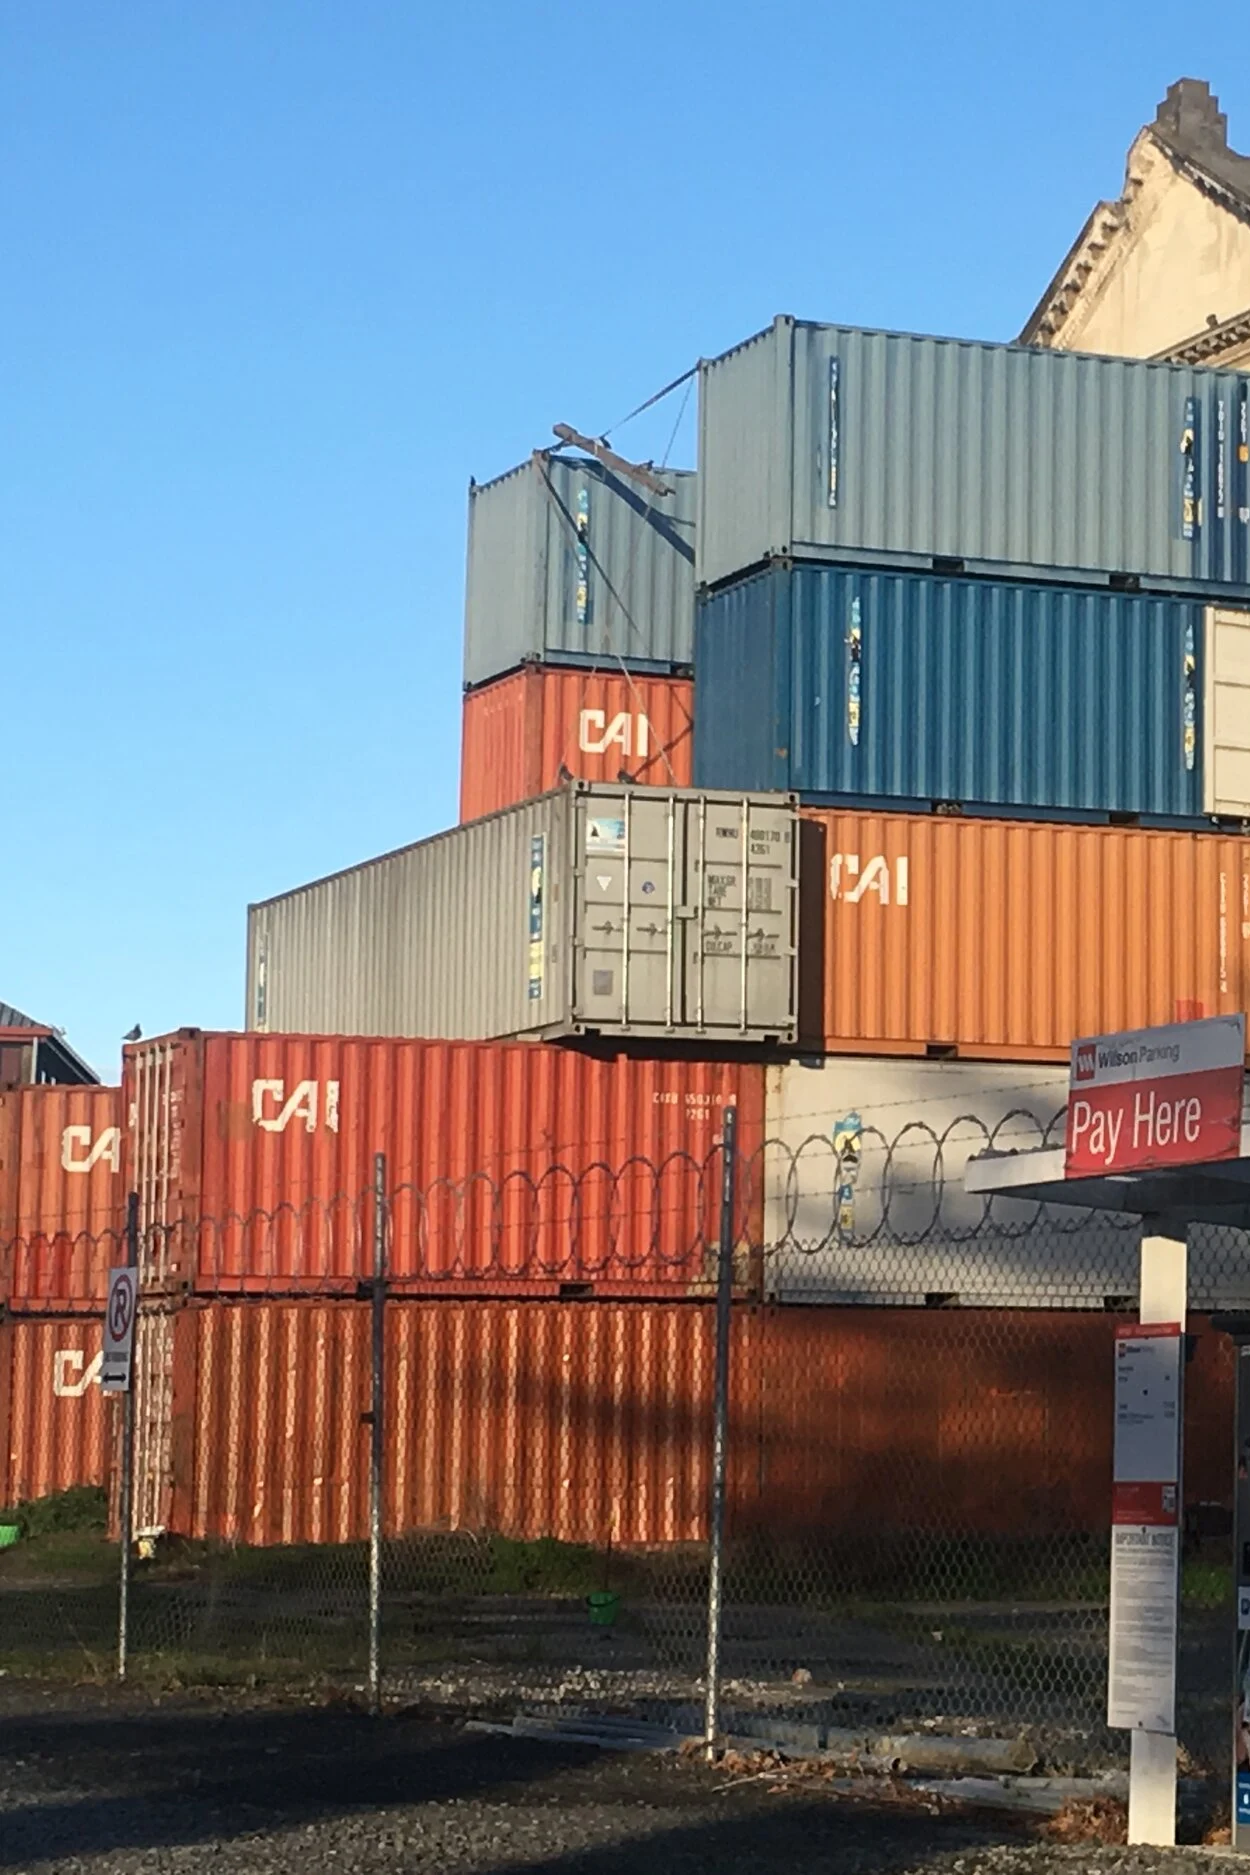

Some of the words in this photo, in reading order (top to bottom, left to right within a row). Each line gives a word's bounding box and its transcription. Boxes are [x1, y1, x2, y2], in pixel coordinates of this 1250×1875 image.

[579, 709, 648, 757] CAI
[829, 853, 908, 906] CAI
[1098, 1048, 1138, 1069] Wilson
[1139, 1043, 1180, 1063] Parking
[252, 1079, 340, 1133] CAI
[1072, 1101, 1124, 1165] Pay
[1133, 1091, 1201, 1149] Here
[61, 1125, 121, 1173] CA
